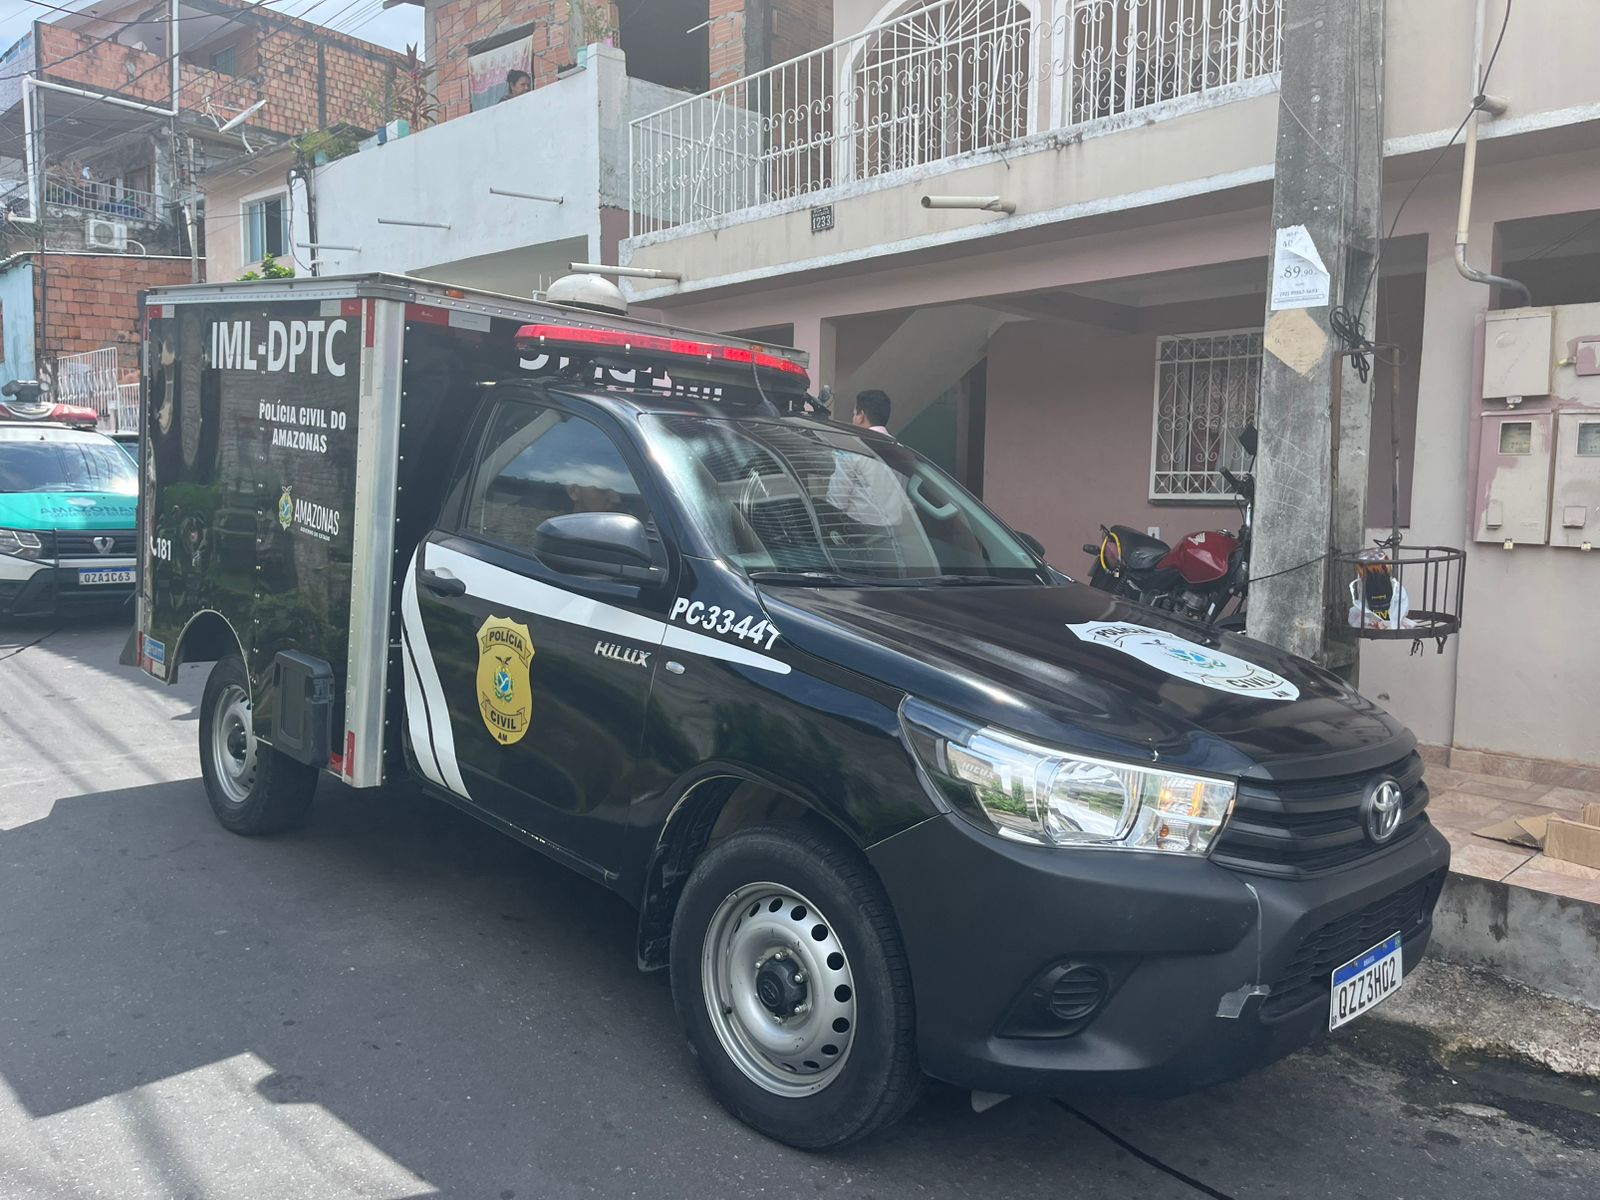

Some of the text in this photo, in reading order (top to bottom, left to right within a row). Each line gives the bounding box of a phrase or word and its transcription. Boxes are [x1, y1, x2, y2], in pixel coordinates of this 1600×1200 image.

[812, 214, 831, 229] 1233
[211, 319, 347, 377] IML-DPTC
[259, 399, 346, 430] POLÍCIA CIVIL DO
[272, 428, 327, 454] AMAZONAS
[294, 498, 340, 536] AMAZONAS
[156, 537, 172, 561] 181
[84, 572, 131, 583] QZA1C63
[489, 629, 523, 652] POLÍCIA
[593, 640, 652, 668] HILUX
[1225, 676, 1276, 689] CIVIL
[490, 710, 517, 730] CIVIL
[1338, 956, 1397, 1020] QZZ3H02
